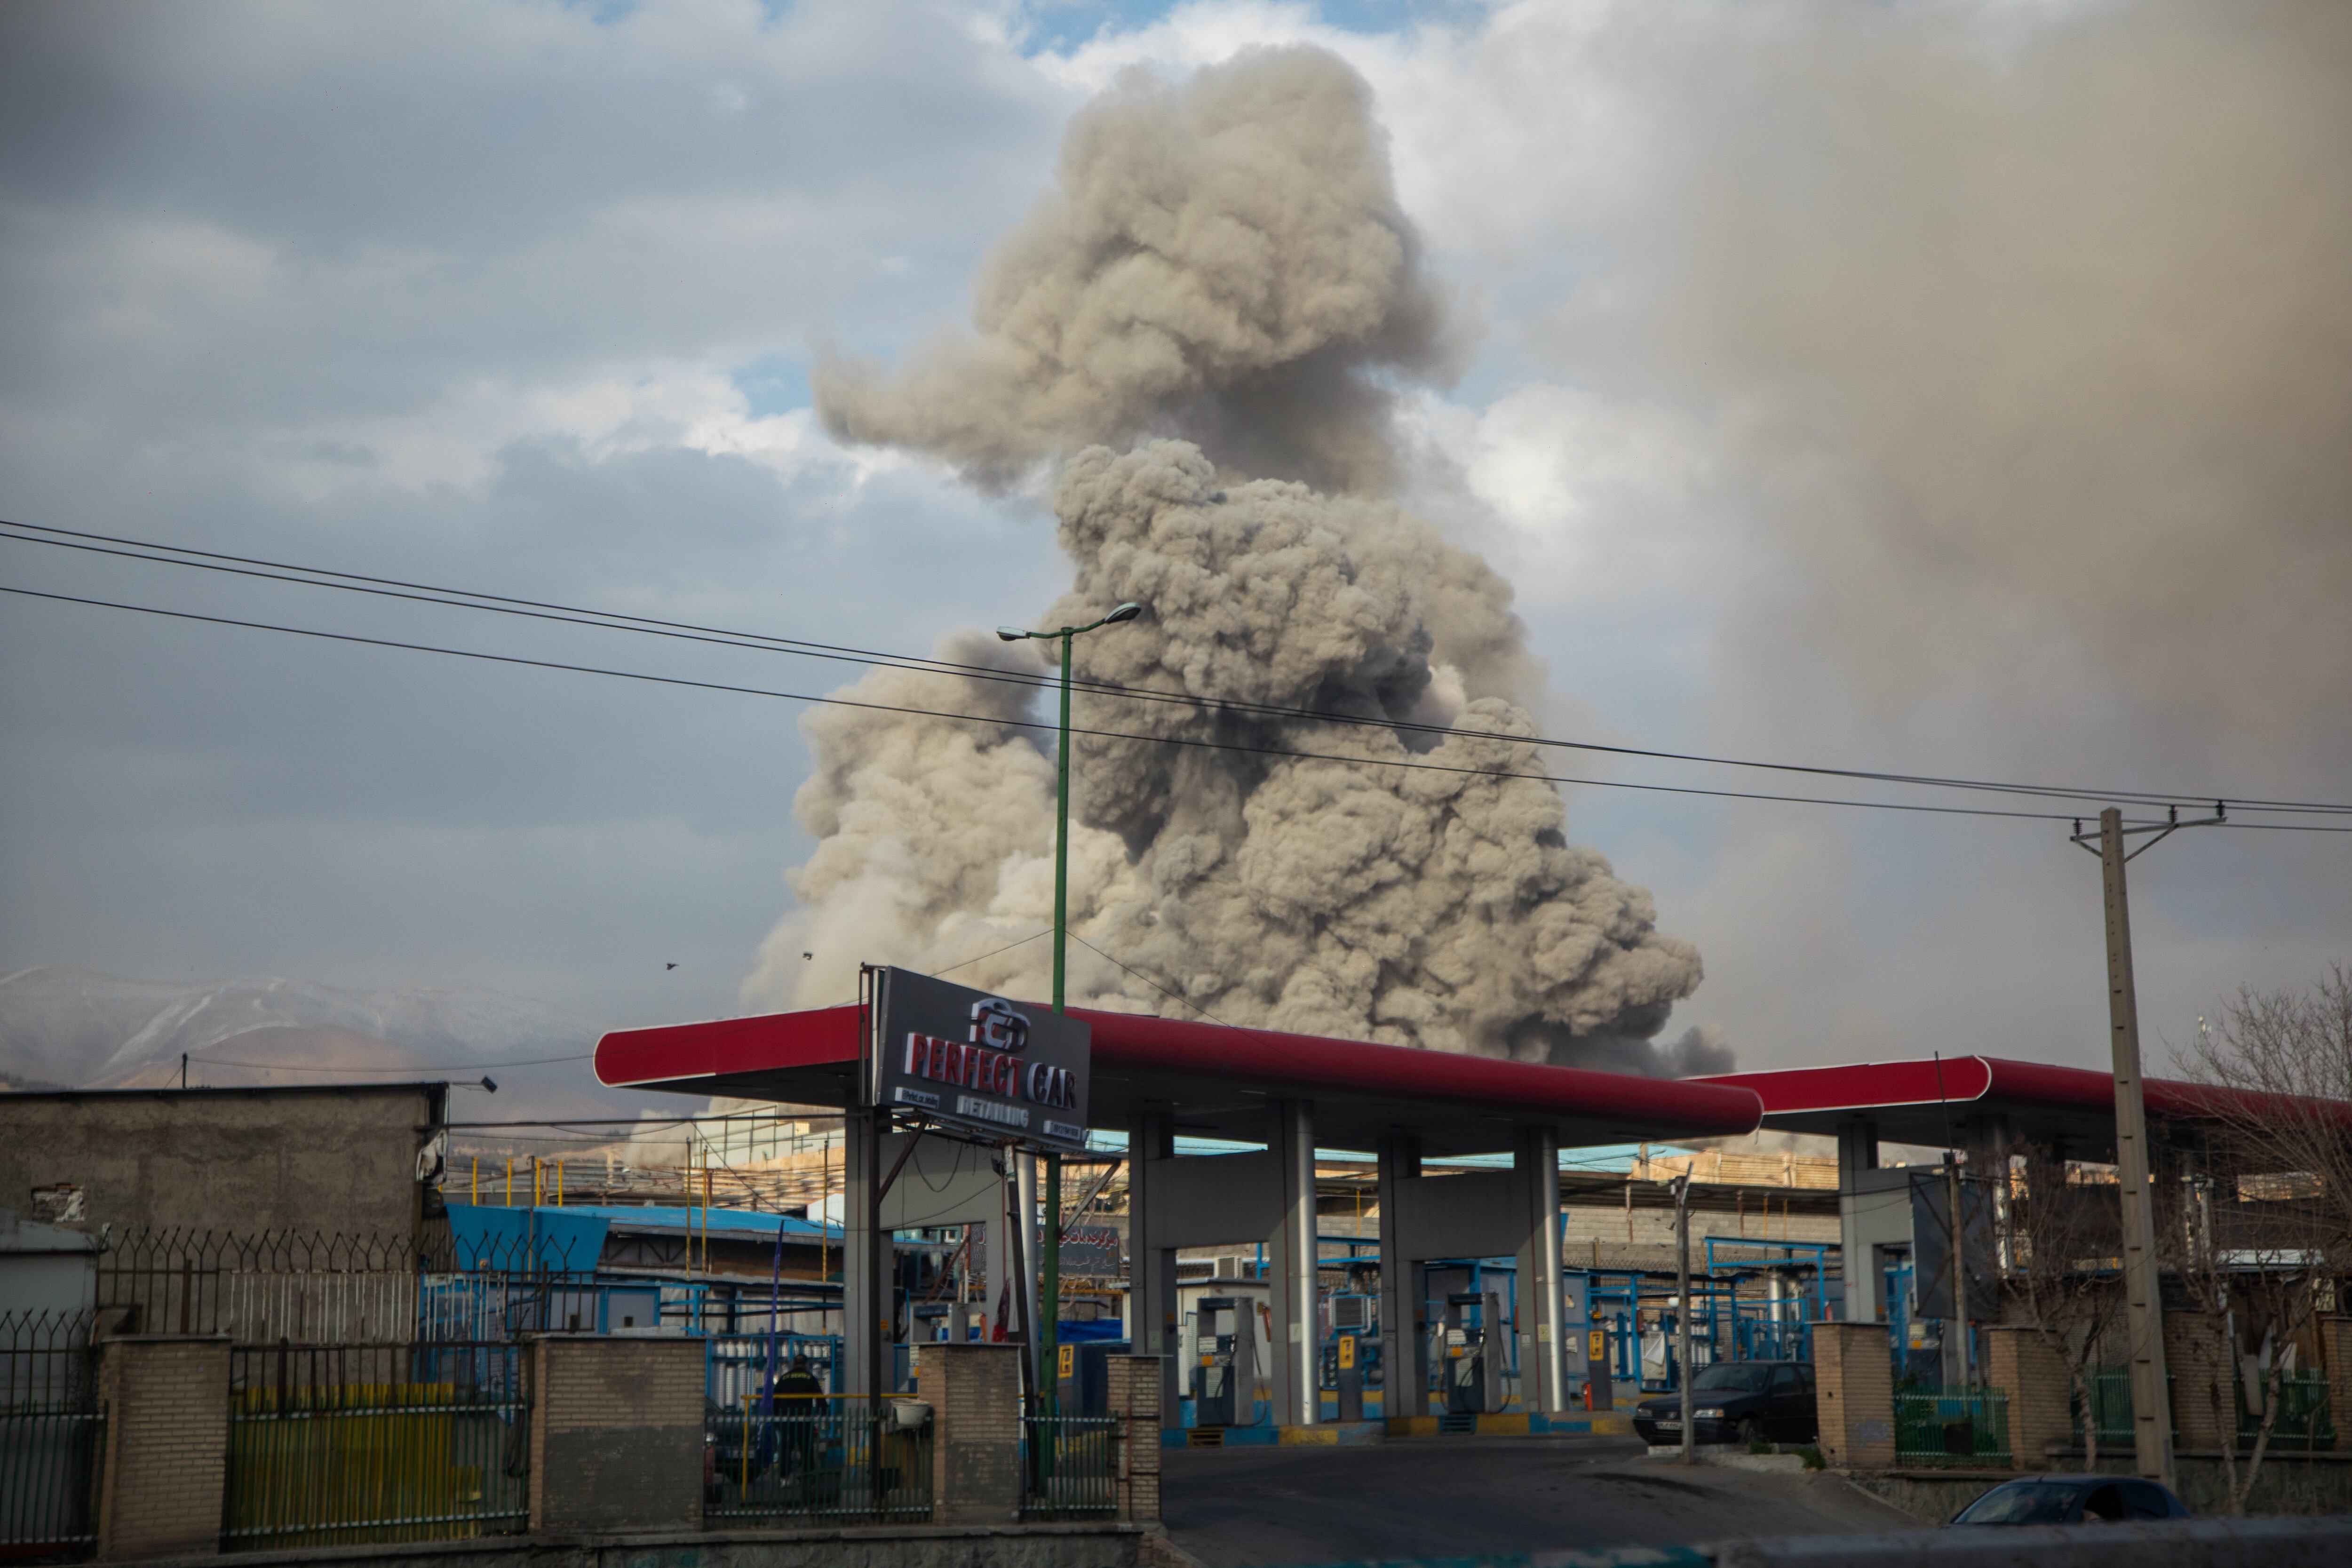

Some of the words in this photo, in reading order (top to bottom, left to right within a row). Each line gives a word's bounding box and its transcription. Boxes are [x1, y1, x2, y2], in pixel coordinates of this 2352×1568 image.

[905, 1032, 1024, 1097] PERFECT
[1027, 1062, 1076, 1110] CAR
[956, 1096, 1029, 1128] DETAILING
[1070, 1228, 1099, 1245] خدمات
[1097, 1229, 1118, 1250] مرکز
